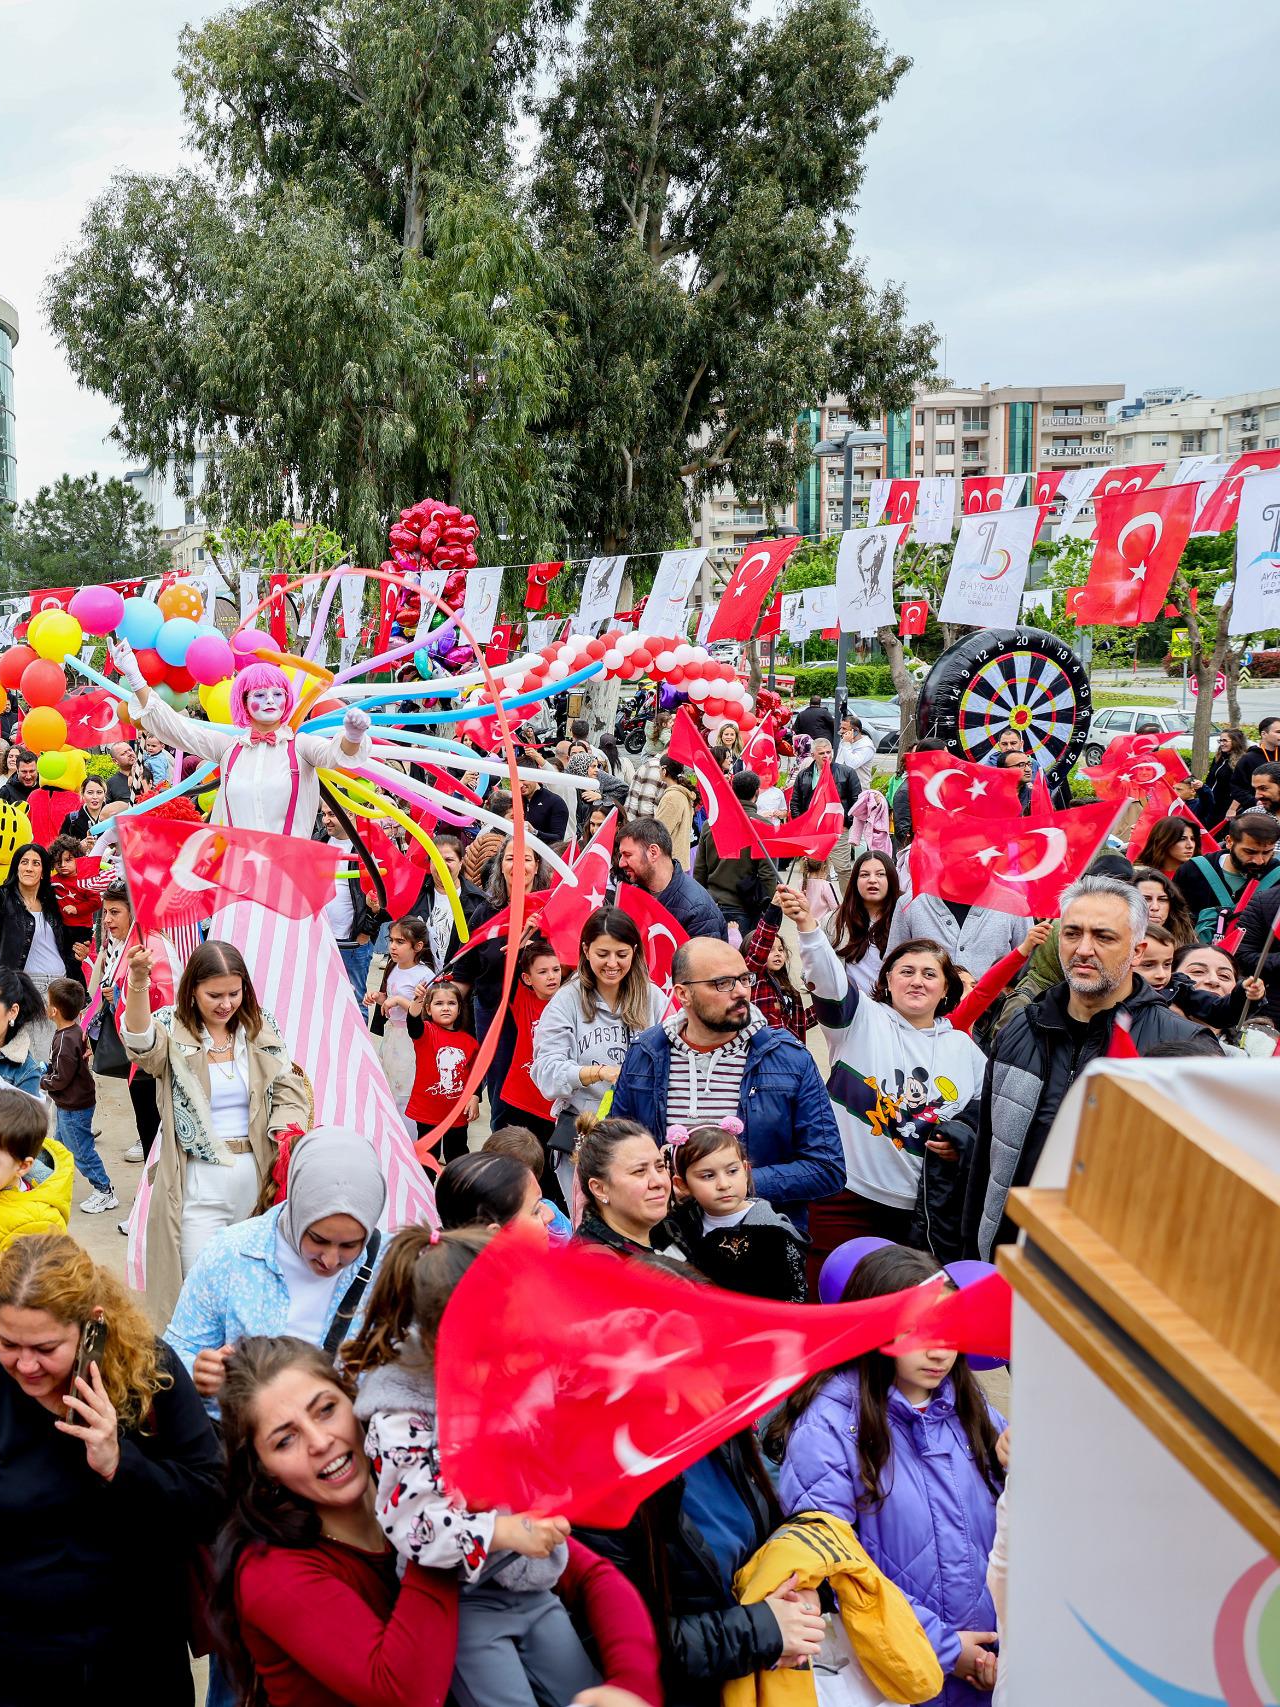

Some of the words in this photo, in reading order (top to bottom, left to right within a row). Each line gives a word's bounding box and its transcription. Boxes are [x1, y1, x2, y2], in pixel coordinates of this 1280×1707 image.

[997, 641, 1005, 651] 5
[1016, 636, 1028, 646] 20
[975, 650, 989, 663] 12
[1056, 647, 1067, 660] 18
[961, 669, 971, 678] 9
[1072, 665, 1080, 673] 4
[1191, 677, 1223, 690] DR
[949, 688, 962, 701] 14
[1079, 684, 1088, 698] 13
[948, 739, 957, 747] 8
[1076, 731, 1087, 744] 10
[1065, 752, 1077, 766] 15
[1051, 772, 1060, 782] 2
